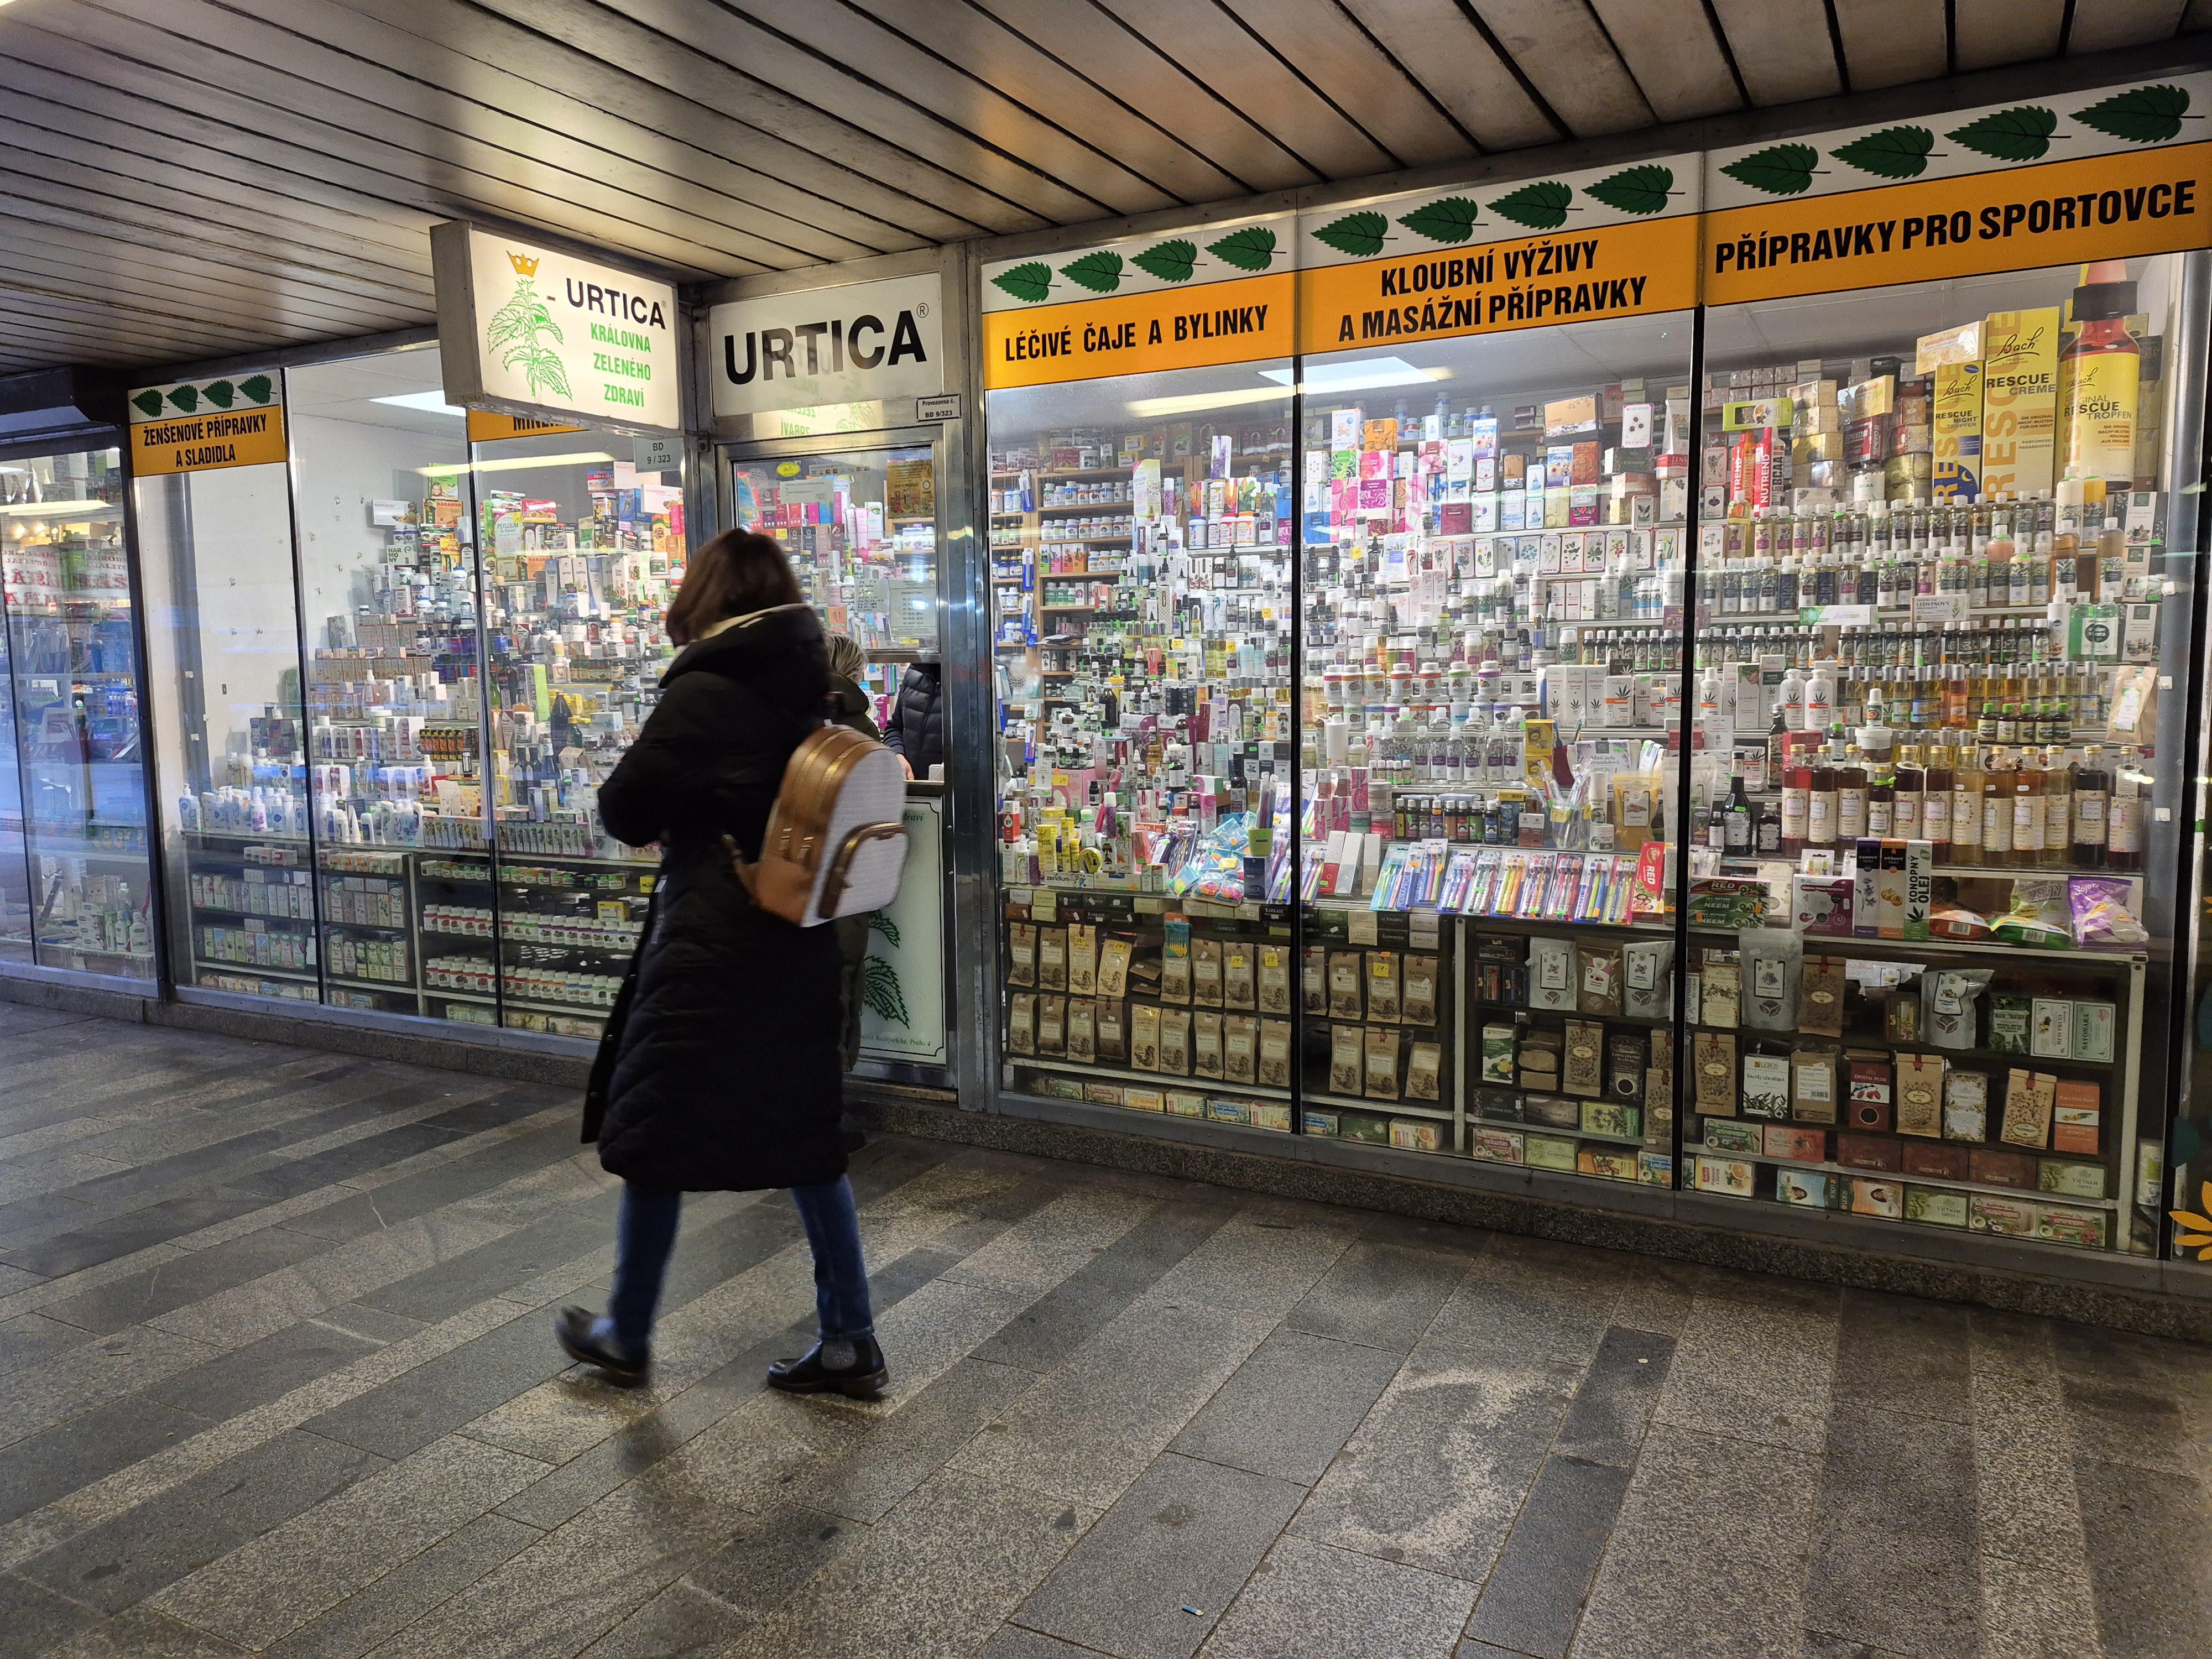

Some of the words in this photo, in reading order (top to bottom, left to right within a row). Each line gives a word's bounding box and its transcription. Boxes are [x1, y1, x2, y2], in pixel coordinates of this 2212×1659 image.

[1715, 218, 1896, 275] PŘÍPRAVKY
[1902, 206, 1973, 250] PRO
[1979, 180, 2195, 242] SPORTOVCE
[1381, 247, 1495, 298] KLOUBNÍ
[1505, 239, 1599, 278] VÝŽIVY
[1339, 315, 1354, 342] A
[1360, 294, 1483, 338] MASÁŽNÍ
[1489, 275, 1648, 326] PŘÍPRAVKY
[590, 322, 651, 353] KRÁLOVNA
[1005, 324, 1072, 362] LÉČIVÉ
[1083, 320, 1136, 352] ČAJE
[1148, 320, 1162, 345] A
[1174, 304, 1269, 343] BYLINKY
[1996, 326, 2044, 357] Bach
[593, 352, 651, 380] ZELENÉHO
[1943, 374, 1978, 397] Bach
[1986, 373, 2049, 388] RESCUE
[2009, 384, 2056, 396] CREME
[603, 384, 645, 408] ZDRAVÍ
[1936, 410, 1973, 420] RESCUE
[2064, 401, 2120, 418] RESCUE
[2087, 411, 2132, 420] TROPFEN
[143, 418, 205, 447] ŽENŠENOVÉ
[206, 413, 268, 438] PŘÍPRAVKY
[176, 452, 183, 468] A
[185, 443, 237, 467] SLADIDLA
[653, 442, 664, 451] BD
[1671, 455, 1688, 463] ŽENŠ
[1761, 453, 1770, 504] NUTREND
[1772, 456, 1783, 486] BCAA
[1046, 874, 1070, 882] zendium
[1646, 865, 1656, 885] RED
[1908, 855, 1919, 903] KONOPNÝ
[1397, 873, 1411, 905] CURAPROX
[1918, 875, 1929, 904] OLEJ
[2029, 885, 2062, 901] VEGAN
